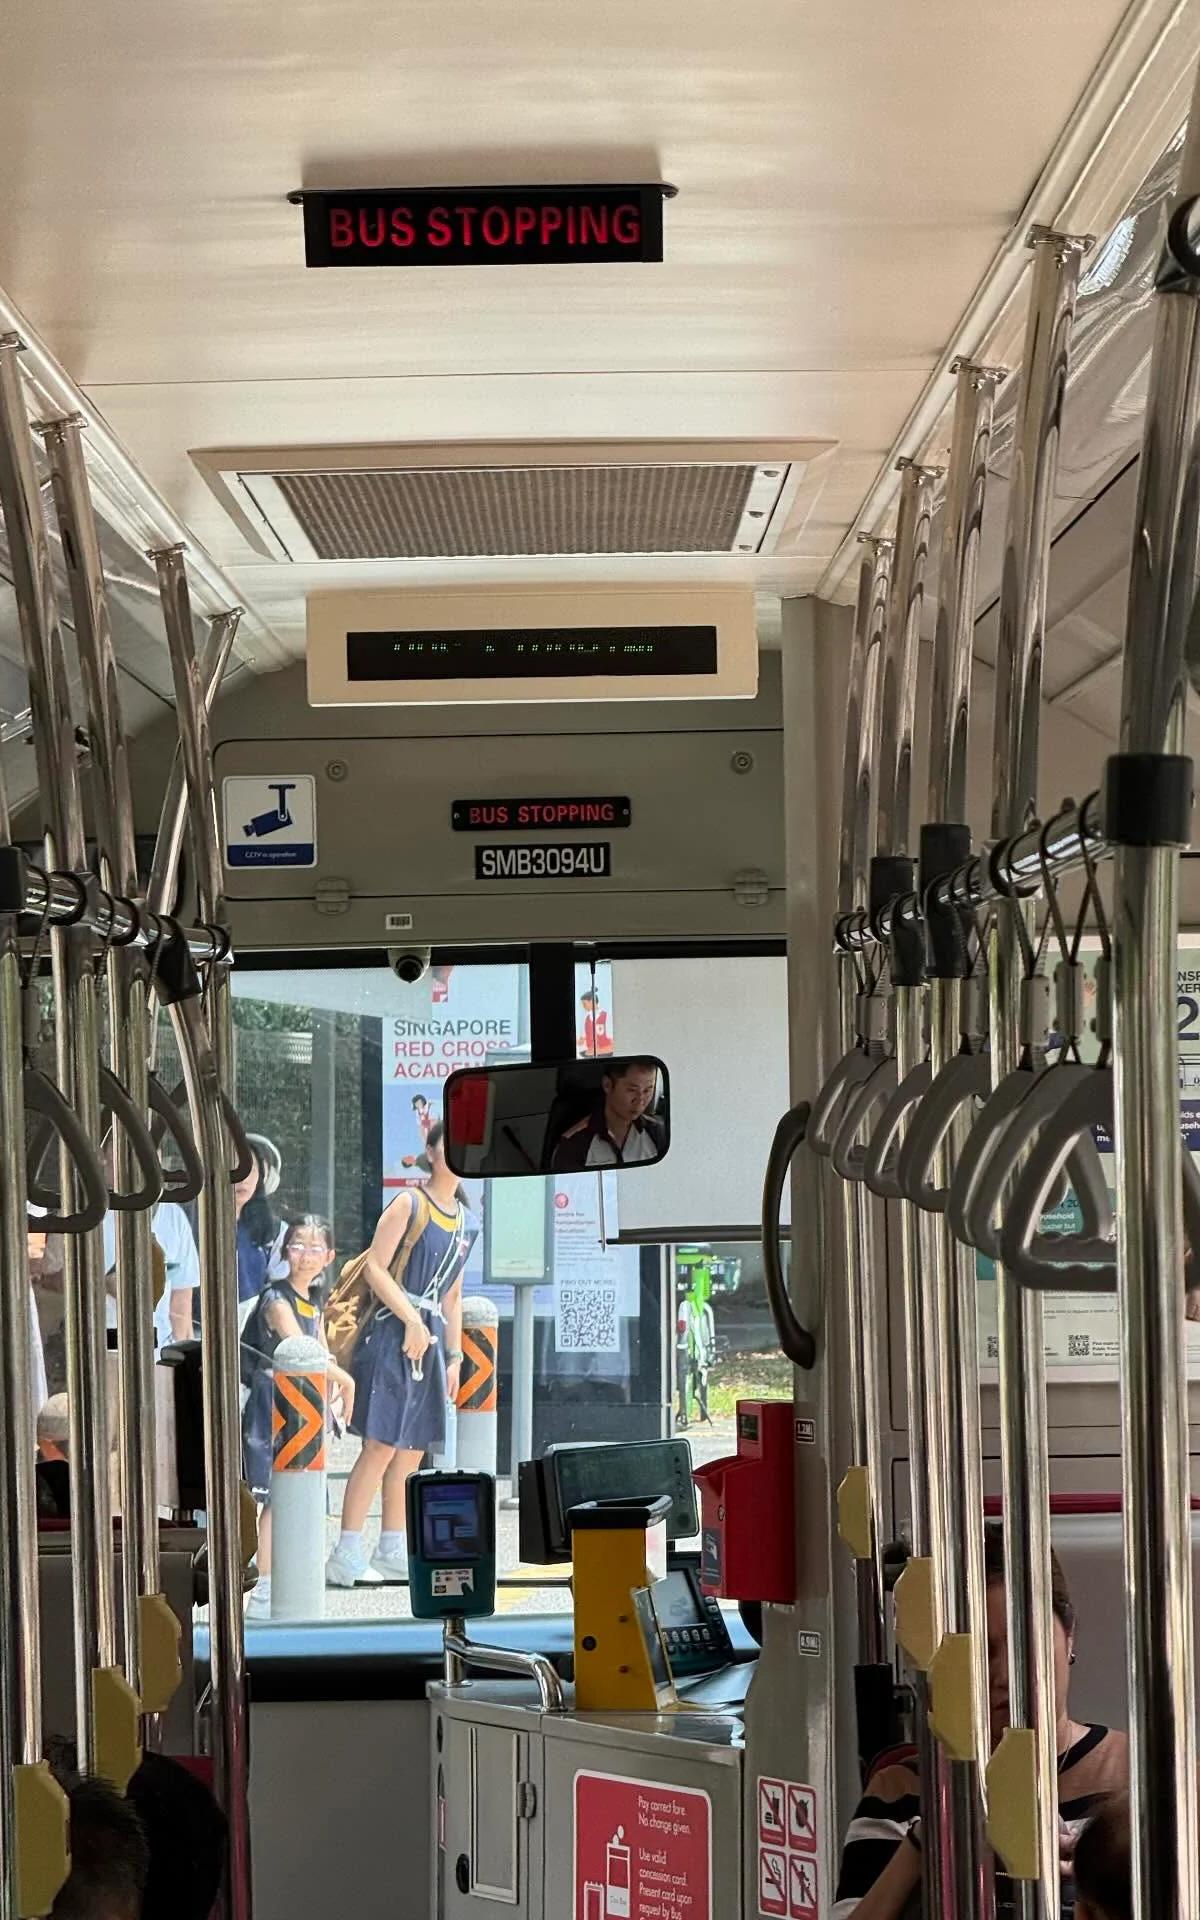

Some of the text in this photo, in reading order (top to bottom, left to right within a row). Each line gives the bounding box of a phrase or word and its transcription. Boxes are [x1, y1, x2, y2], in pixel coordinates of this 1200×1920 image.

[329, 205, 640, 247] BUS STOPPING
[469, 804, 615, 824] BUS STOPPING
[482, 848, 605, 875] SMB3094U
[394, 1020, 511, 1036] SINGAPORE
[394, 1041, 435, 1057] RED
[638, 1795, 649, 1812] Pay
[650, 1801, 671, 1814] correct
[638, 1812, 648, 1826] No
[650, 1813, 672, 1834] change
[639, 1848, 667, 1865] Use valid
[639, 1868, 671, 1883] concession
[639, 1882, 693, 1907] Present card upon
[639, 1903, 662, 1916] request
[662, 1903, 670, 1919] by
